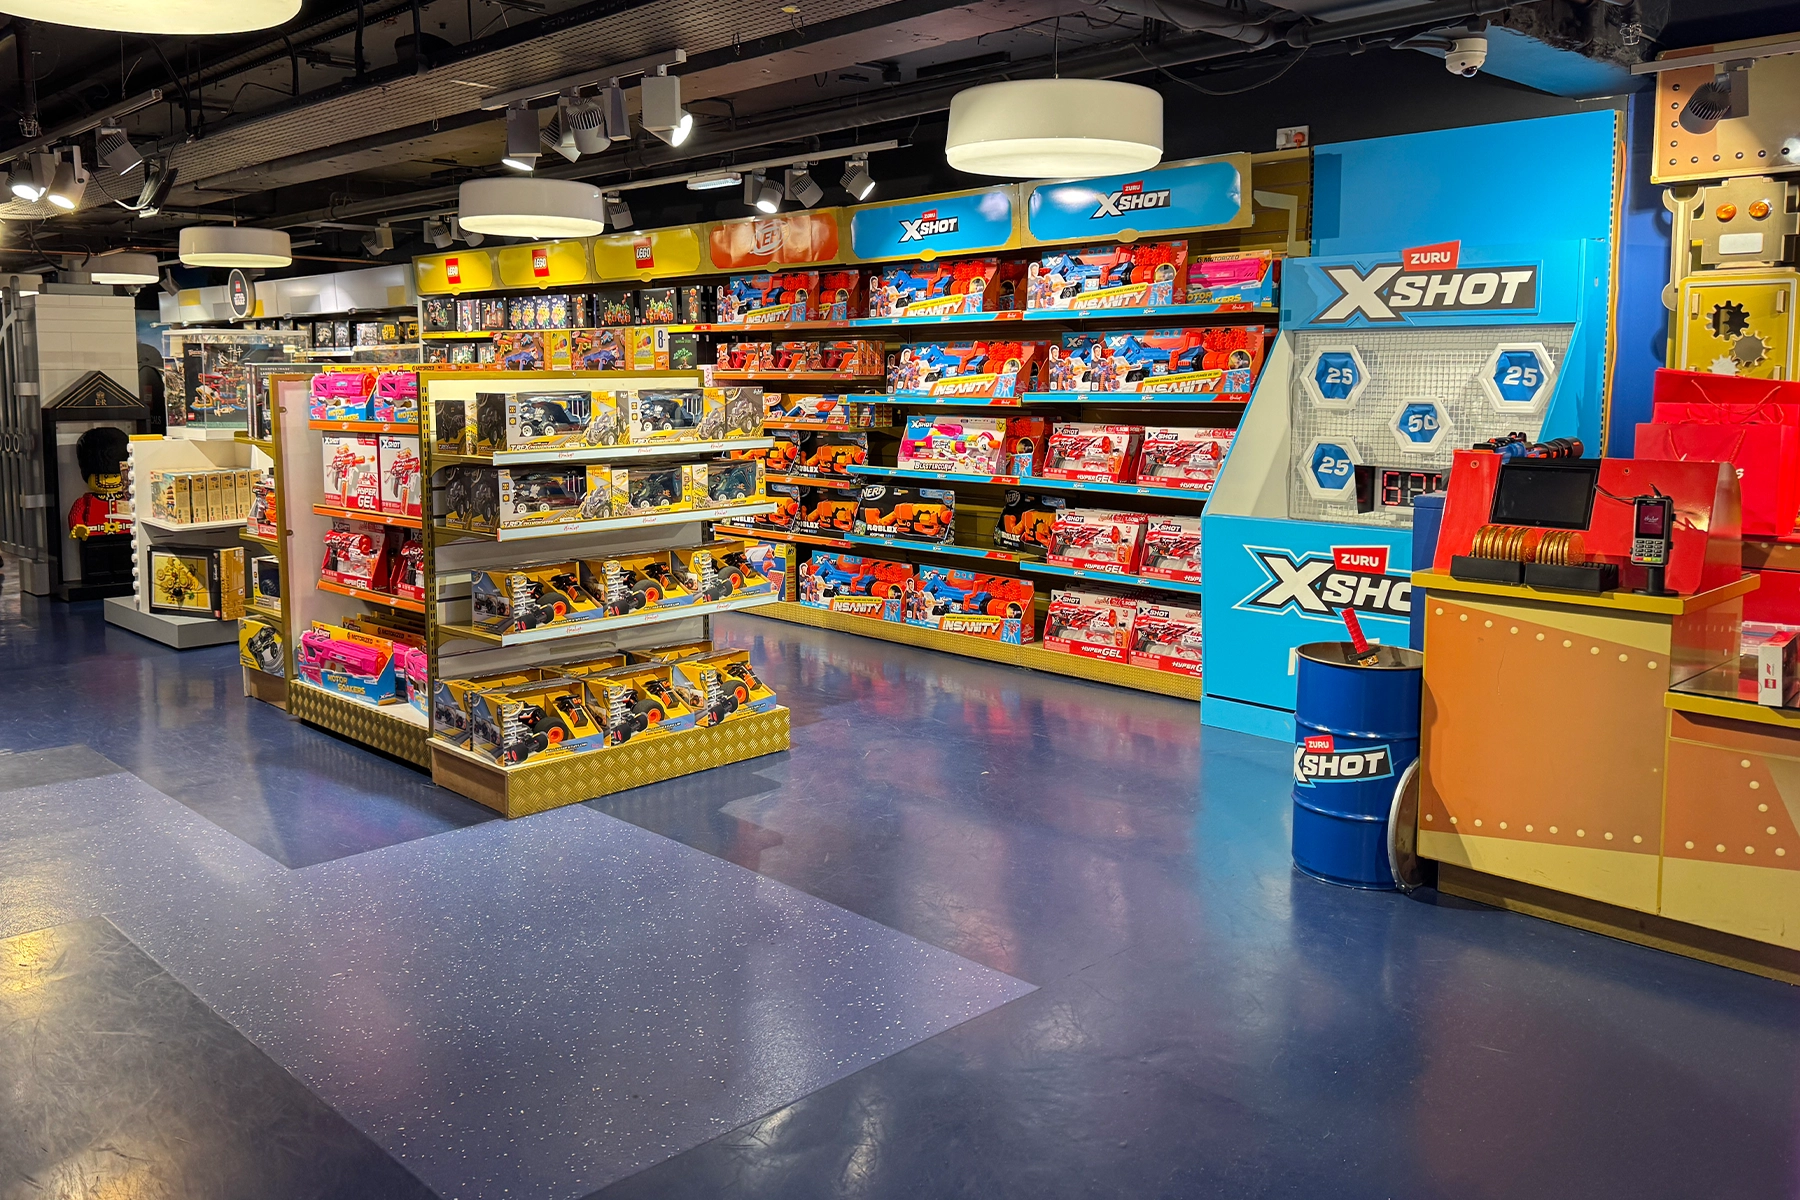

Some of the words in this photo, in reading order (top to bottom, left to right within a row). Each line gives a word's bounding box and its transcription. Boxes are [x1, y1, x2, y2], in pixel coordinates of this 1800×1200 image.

[1092, 190, 1170, 218] XSHOT
[900, 217, 958, 242] XSHOT
[636, 247, 651, 259] LEGO
[1410, 252, 1451, 265] ZURU
[534, 257, 547, 269] LEGO
[447, 265, 459, 277] LEGO
[1190, 292, 1213, 300] OTOR
[1318, 265, 1534, 321] XSHOT
[1073, 290, 1147, 309] INSANITY
[906, 301, 963, 316] INSANITY
[1325, 366, 1354, 385] 25
[1502, 365, 1538, 387] 25
[933, 381, 996, 396] INSANITY
[1141, 377, 1222, 393] INSANITY
[1406, 413, 1440, 433] 50
[1149, 432, 1178, 440] XSHOT
[798, 465, 819, 473] OBLOX
[1318, 455, 1351, 477] 25
[1095, 475, 1114, 484] GEL
[861, 485, 886, 499] NERF
[357, 496, 377, 510] GEL
[1058, 513, 1084, 523] XSHOT
[799, 520, 820, 529] OBLOX
[866, 524, 898, 533] ROBLOX
[1151, 521, 1182, 532] XSHOT
[1341, 553, 1379, 567] ZURU
[1104, 564, 1126, 575] GEL
[1257, 556, 1411, 612] XSHO
[1054, 594, 1081, 604] XSHOT
[834, 602, 883, 614] INSANITY
[1140, 606, 1170, 618] XSHOT
[943, 620, 1000, 634] INSANITY
[1081, 645, 1102, 653] HYPER
[1101, 647, 1123, 659] GEL
[1172, 660, 1196, 670] HYPER
[327, 675, 348, 684] MOTOR
[337, 683, 366, 695] SOAKERS
[1308, 740, 1329, 749] ZURU
[1294, 747, 1386, 782] XSHOT
